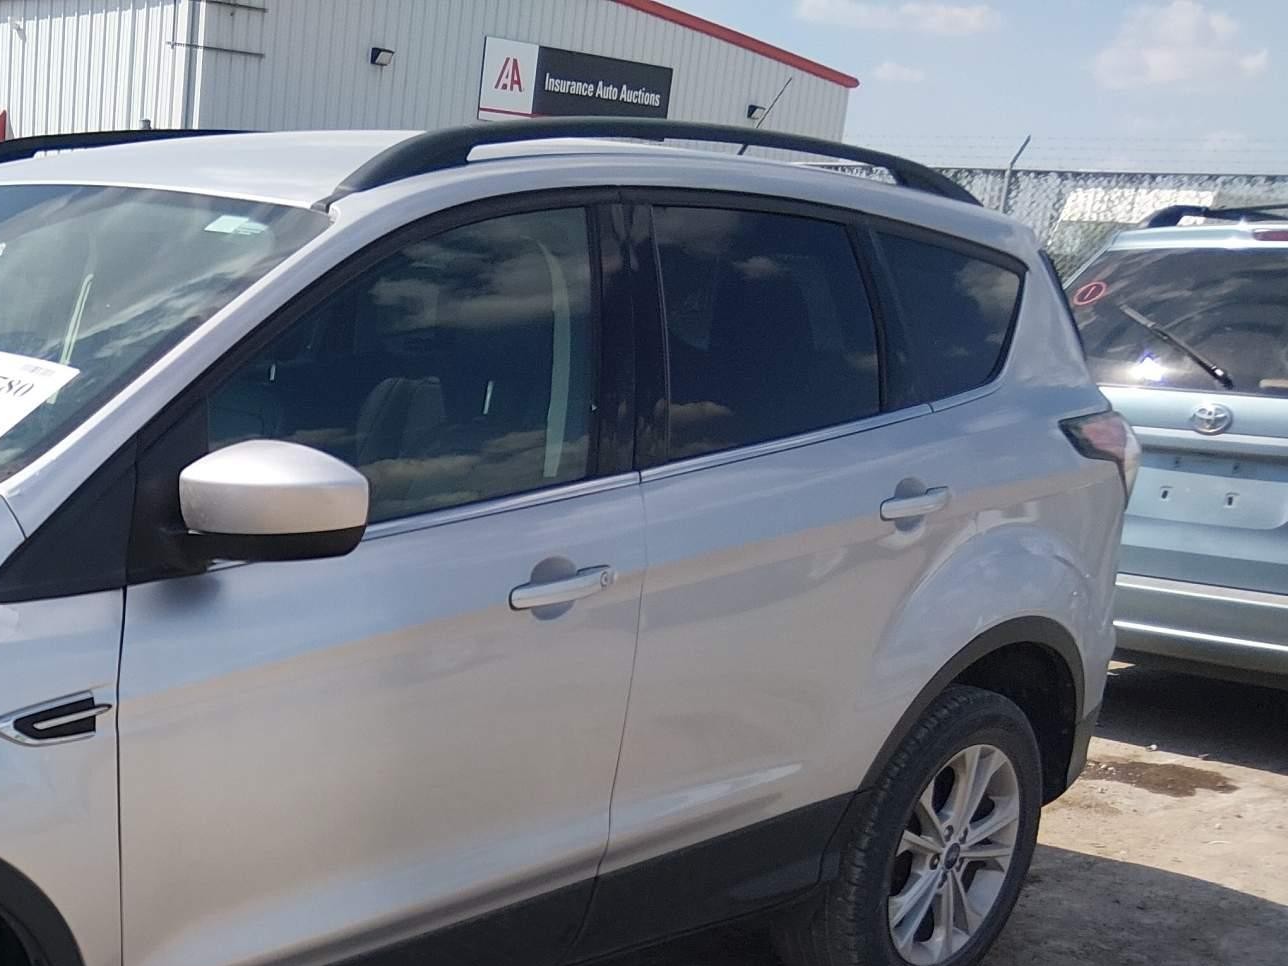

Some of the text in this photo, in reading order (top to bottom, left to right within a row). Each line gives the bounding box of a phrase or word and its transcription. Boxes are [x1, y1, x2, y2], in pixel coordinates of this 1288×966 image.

[544, 72, 661, 107] Insurance Auto Auctions
